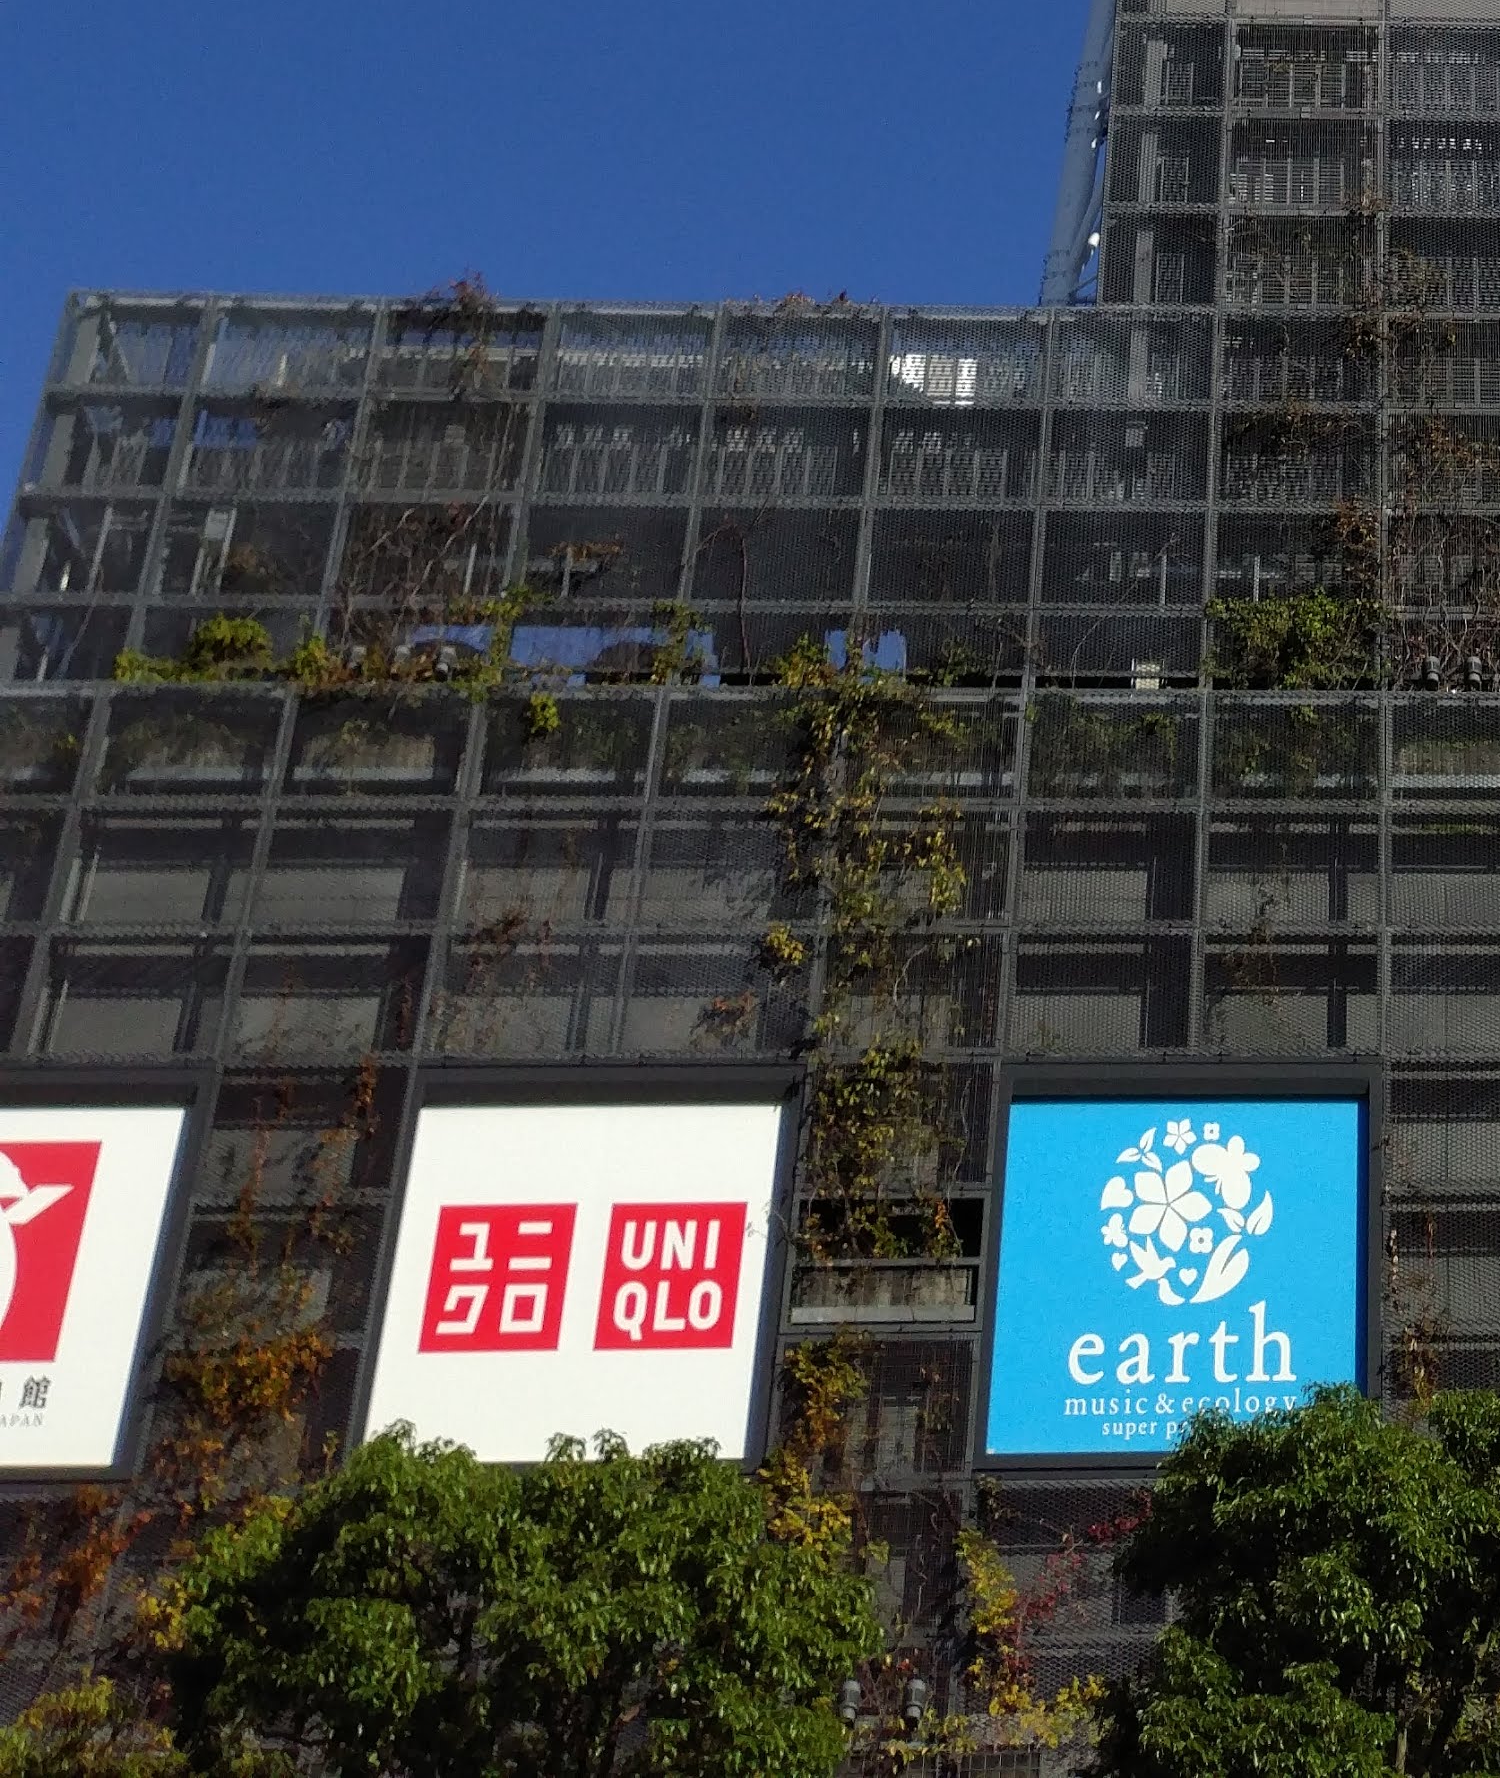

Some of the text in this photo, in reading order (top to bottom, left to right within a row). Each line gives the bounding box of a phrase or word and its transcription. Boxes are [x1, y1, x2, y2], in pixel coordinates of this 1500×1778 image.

[621, 1220, 721, 1270] UNI
[612, 1280, 723, 1340] QLO
[1068, 1300, 1297, 1385] earth
[1102, 1422, 1157, 1440] super
